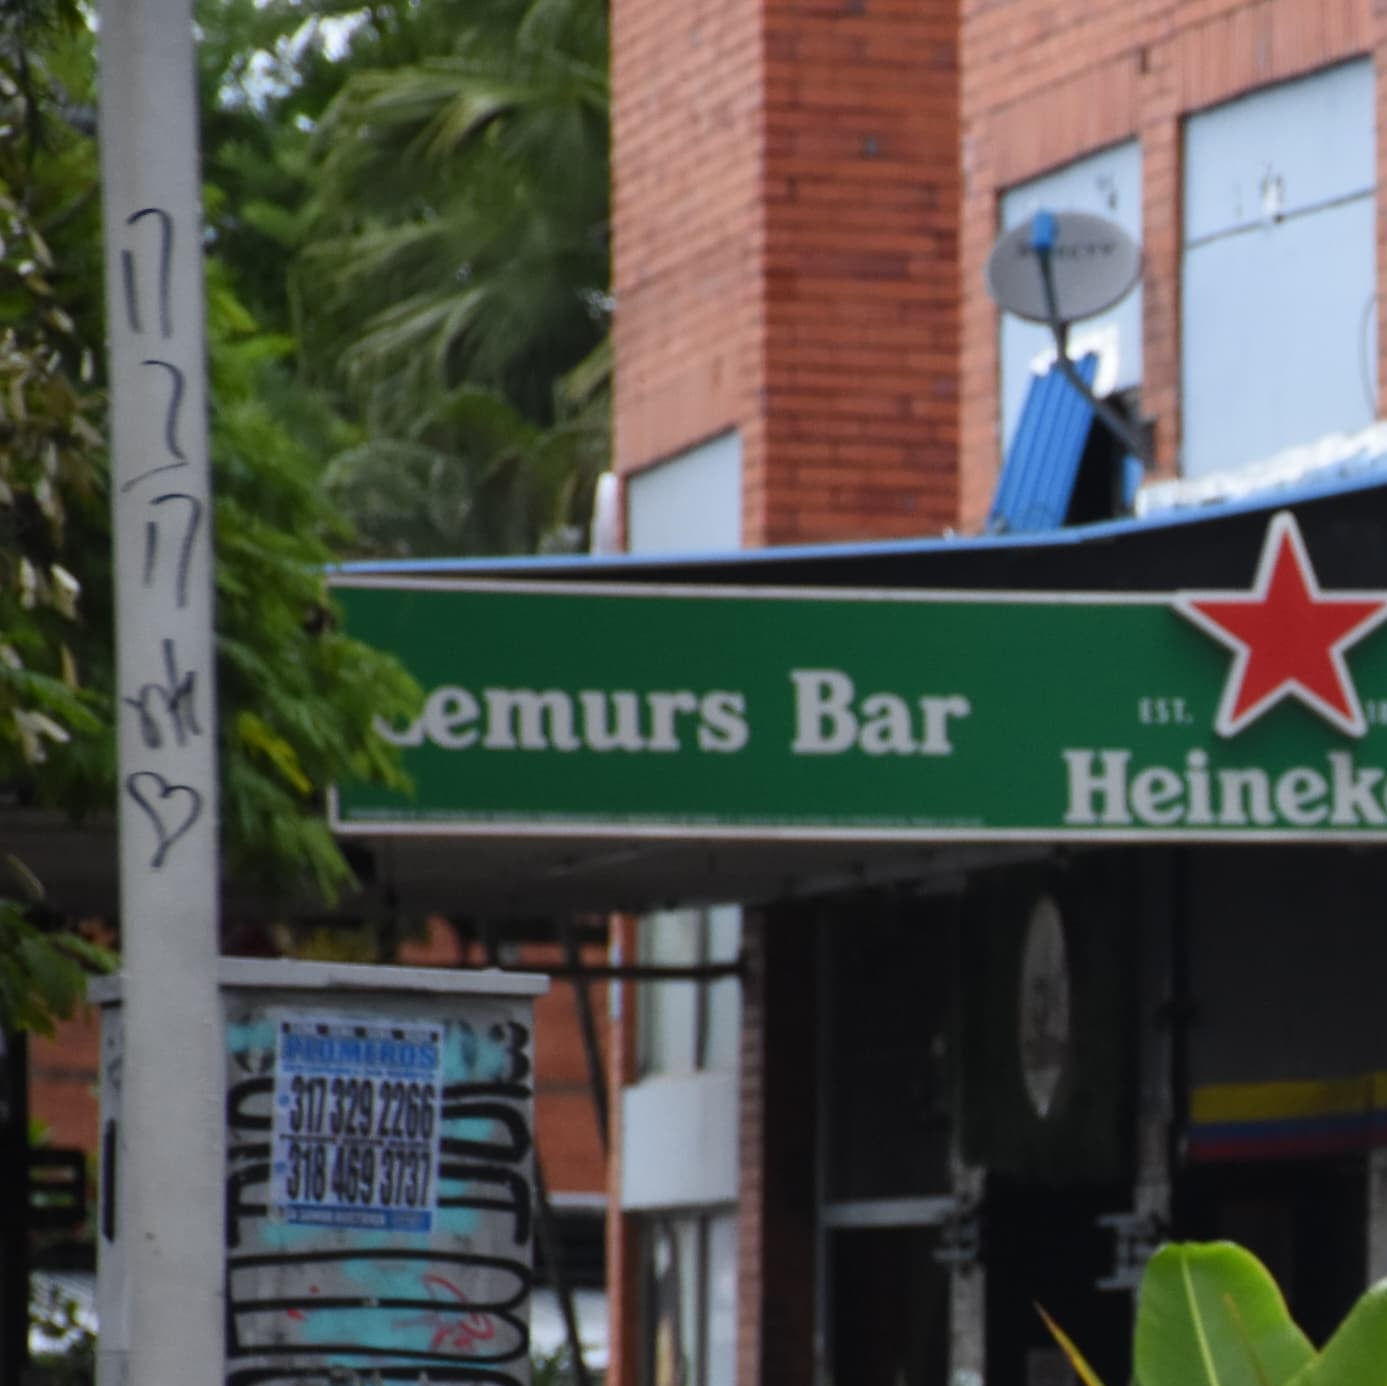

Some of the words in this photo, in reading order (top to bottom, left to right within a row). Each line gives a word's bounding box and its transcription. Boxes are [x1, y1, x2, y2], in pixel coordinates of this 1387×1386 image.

[790, 667, 972, 756] Bar
[1138, 697, 1194, 725] EST.
[289, 1075, 327, 1134] 317
[330, 1078, 374, 1136] 329
[379, 1081, 435, 1139] 2266
[287, 1142, 326, 1201] 318
[332, 1145, 375, 1204] 469
[380, 1149, 430, 1207] 3737
